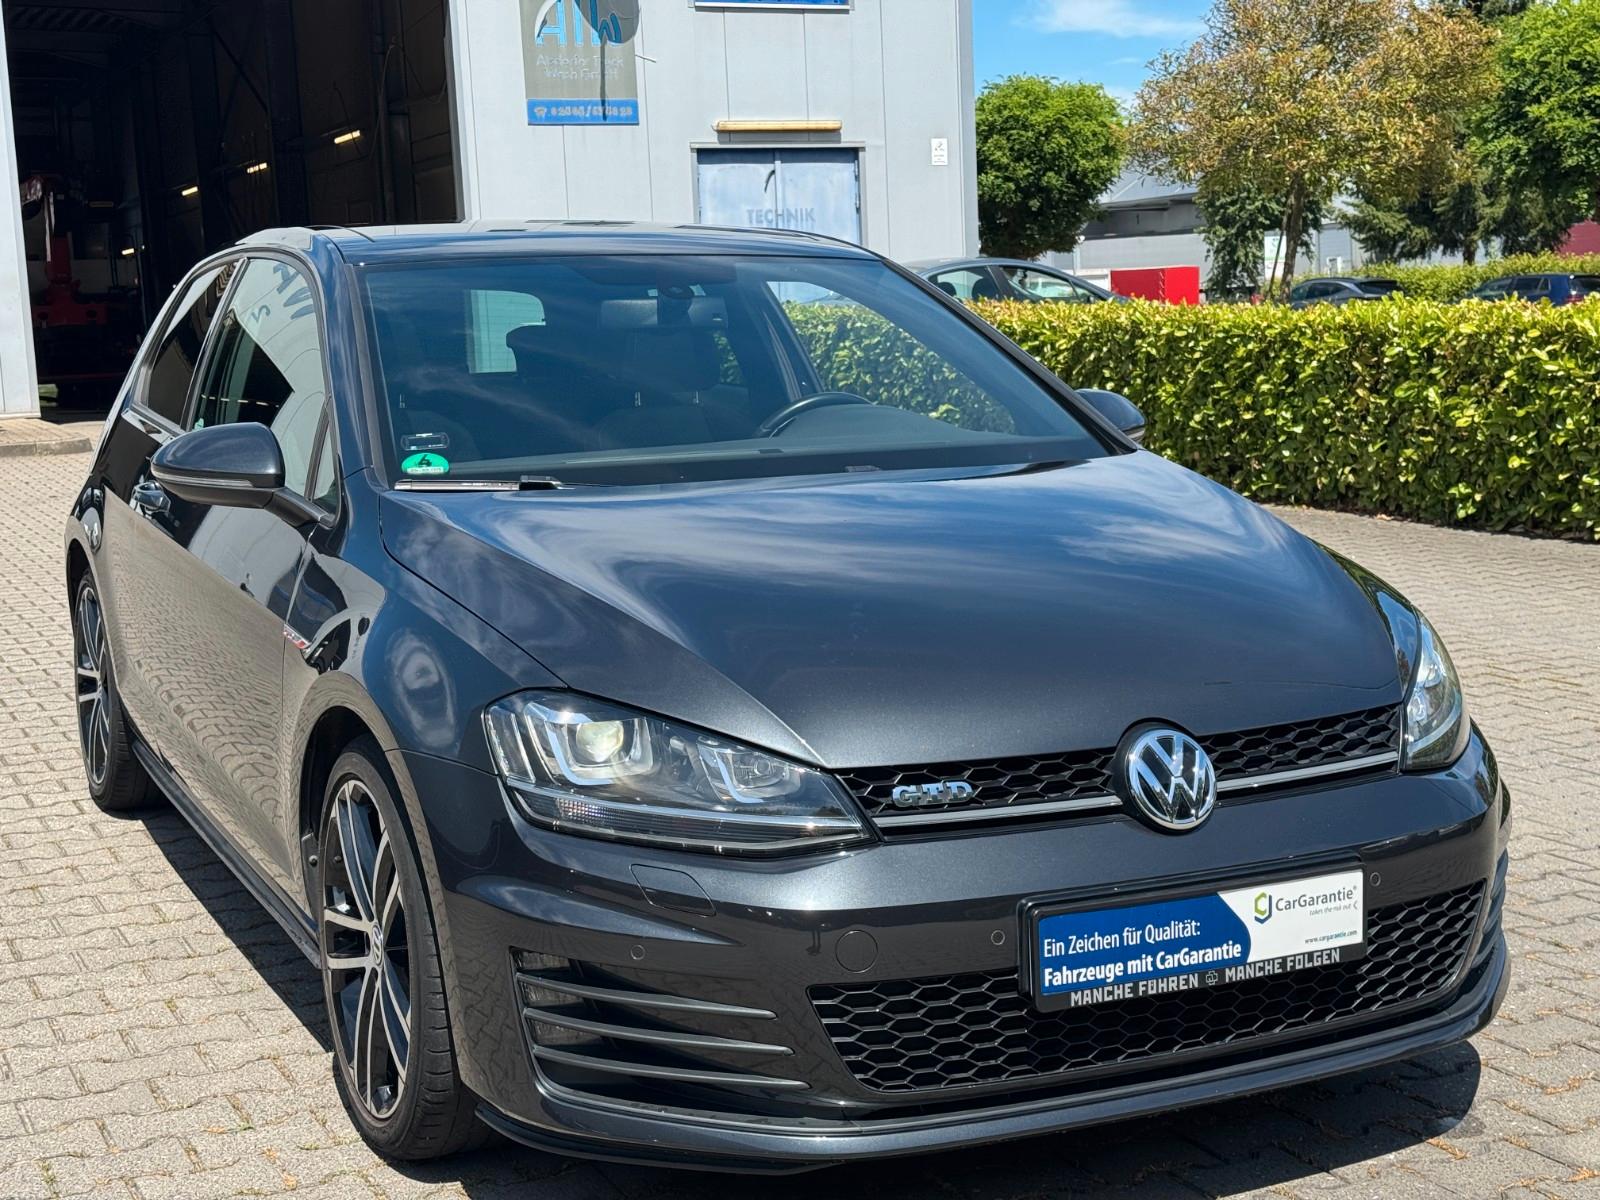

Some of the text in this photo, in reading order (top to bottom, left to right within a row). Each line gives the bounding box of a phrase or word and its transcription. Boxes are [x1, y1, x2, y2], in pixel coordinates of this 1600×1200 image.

[746, 207, 816, 226] TECHNIK
[892, 781, 975, 807] GTD
[1043, 919, 1201, 958] Ein Zeichen für Qualität:
[1044, 940, 1242, 988] Fahrzeuge mit CarGarantie
[1070, 982, 1134, 1007] MANCHE
[1225, 958, 1283, 982] MANCHE
[1286, 948, 1340, 971] FOLGEN
